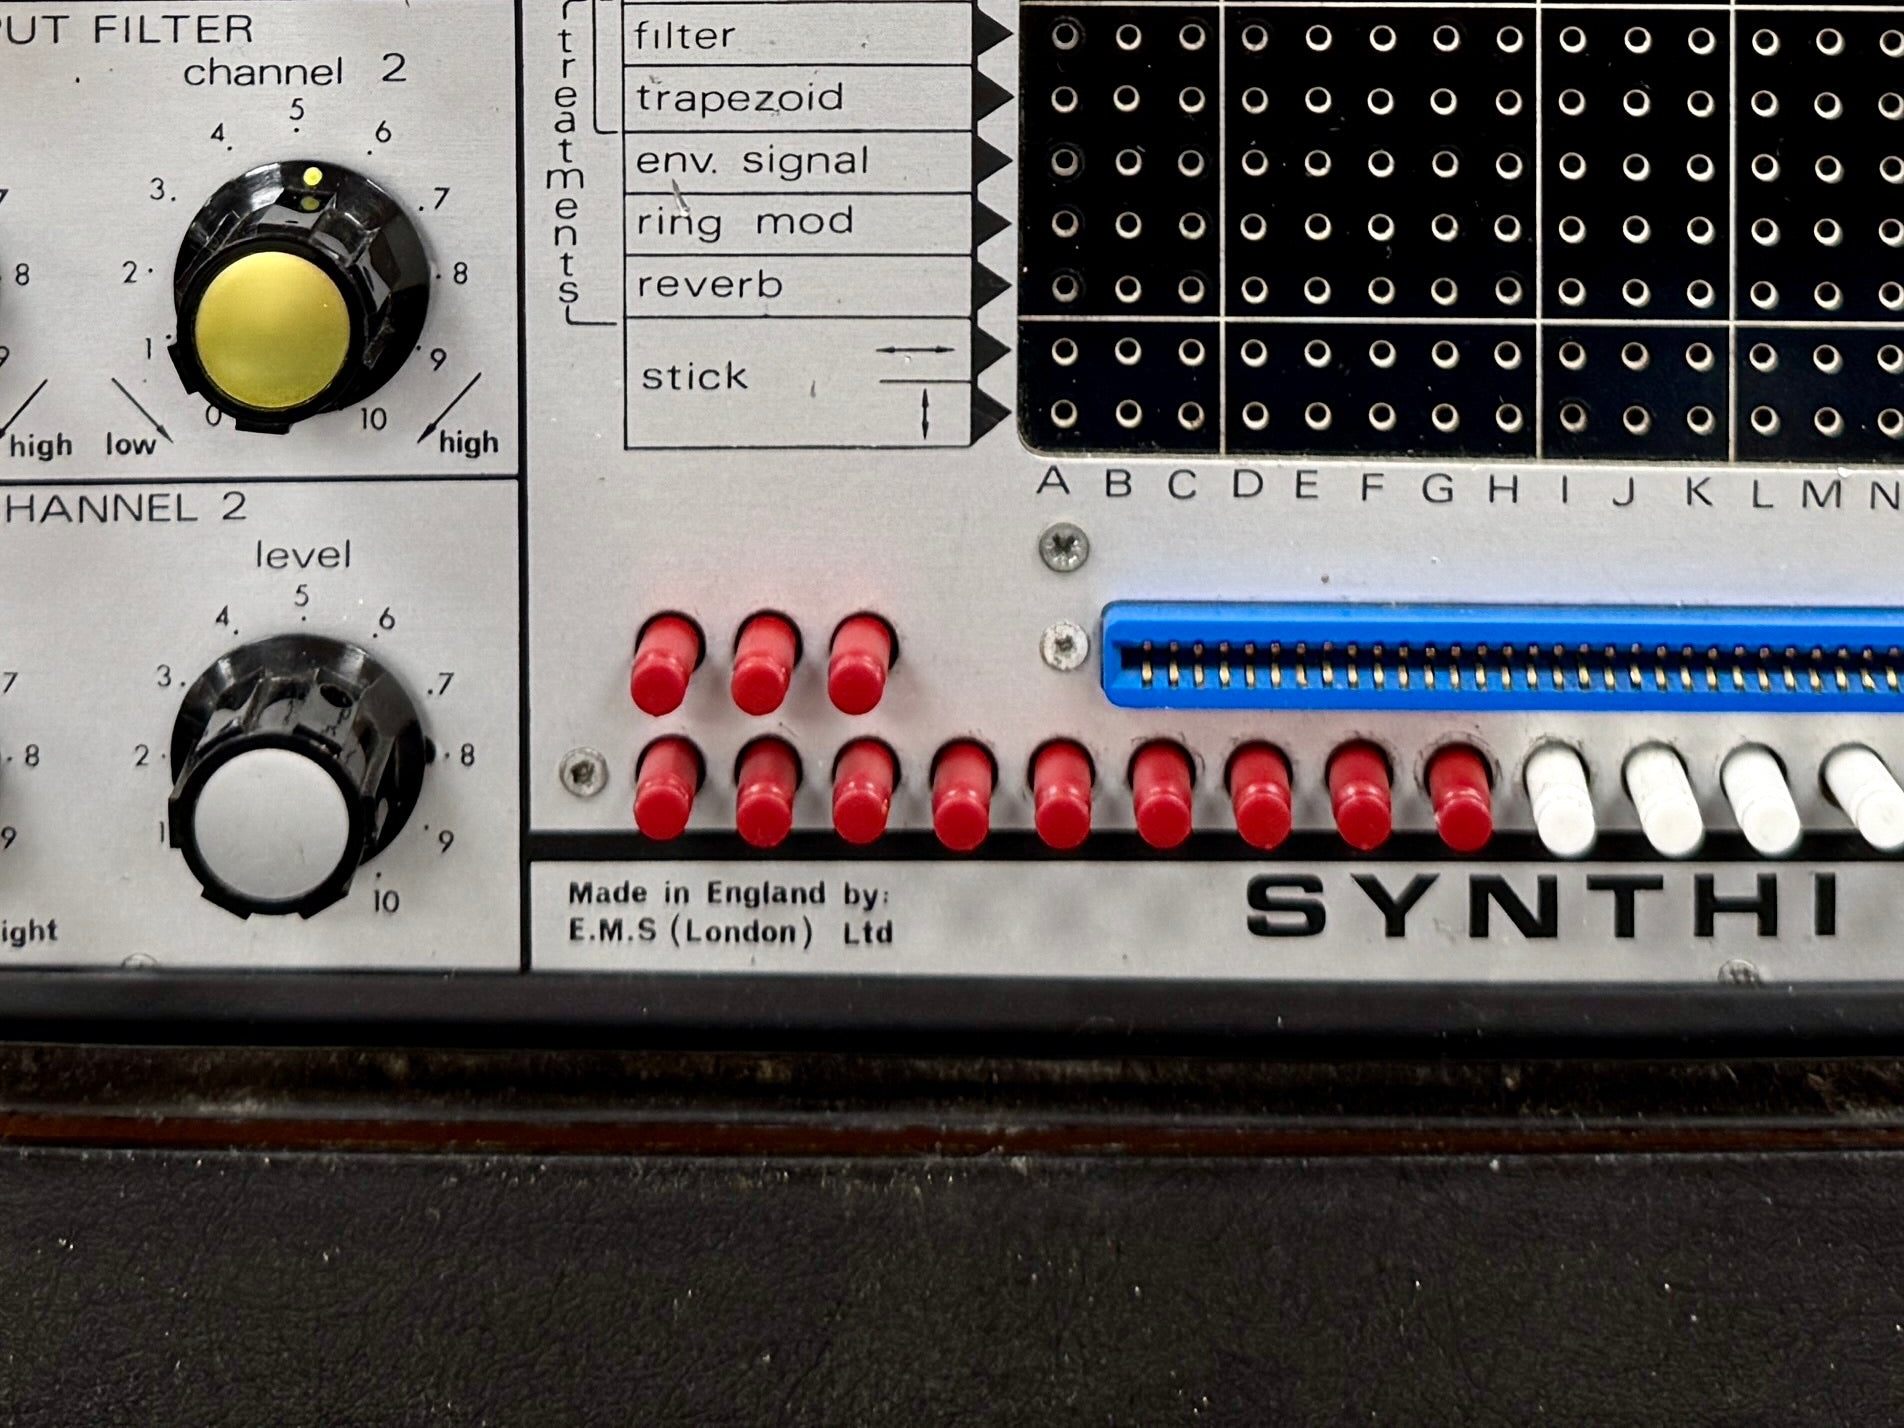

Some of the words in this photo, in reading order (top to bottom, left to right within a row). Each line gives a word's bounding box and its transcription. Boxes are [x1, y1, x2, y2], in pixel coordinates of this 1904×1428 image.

[94, 14, 253, 44] FILTER
[633, 19, 736, 50] filter
[183, 55, 343, 87] channel
[381, 52, 407, 83] 2
[635, 75, 843, 120] trapezoid
[636, 151, 717, 175] env.
[742, 143, 868, 182] signal
[638, 205, 722, 244] ring
[756, 204, 853, 235] mod
[638, 268, 783, 299] reverb
[642, 360, 749, 391] stick
[10, 431, 73, 463] high
[222, 490, 247, 521] 2
[568, 879, 648, 905] Made
[664, 880, 690, 906] in
[707, 880, 826, 910] England
[1246, 871, 1837, 941] SYNTHI
[670, 912, 813, 951] (London)
[843, 919, 893, 946] Ltd
